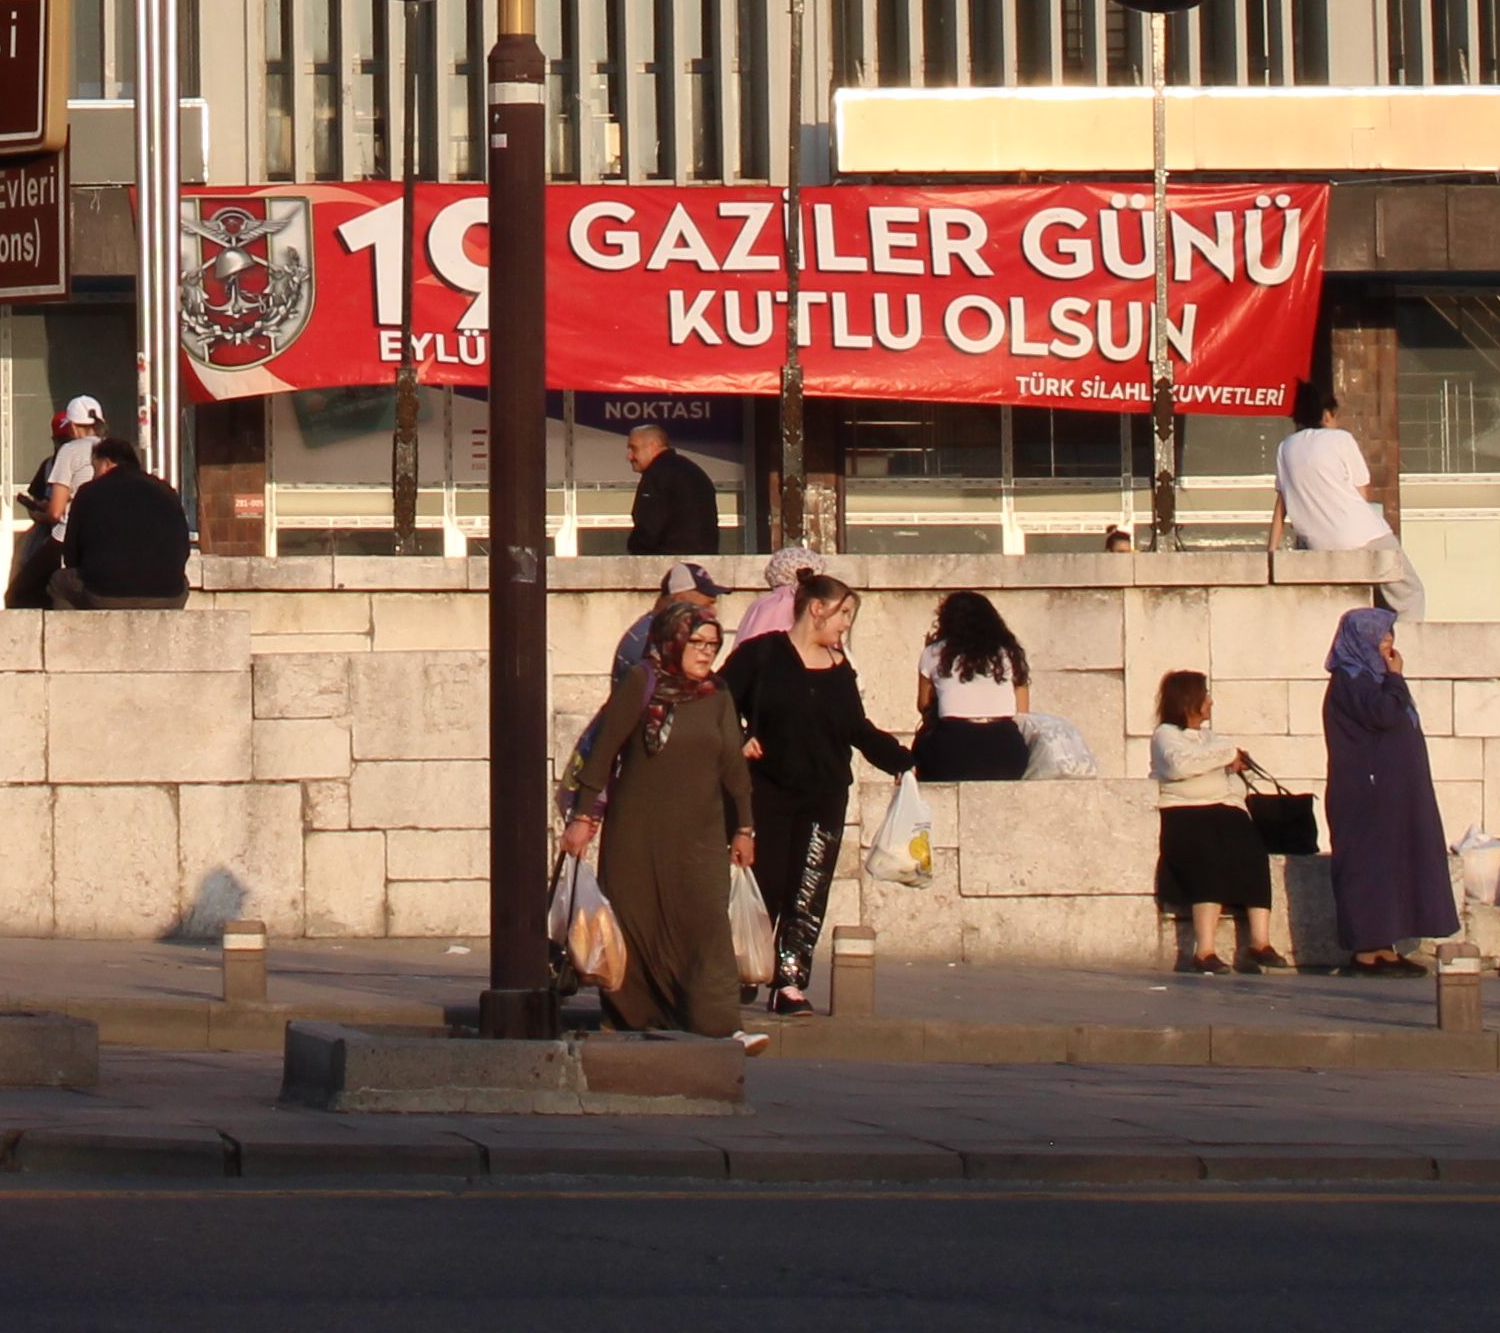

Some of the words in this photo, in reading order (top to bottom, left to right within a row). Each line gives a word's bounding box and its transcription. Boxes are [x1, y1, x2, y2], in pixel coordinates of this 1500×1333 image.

[569, 188, 994, 276] GAZİLER
[1022, 193, 1301, 286] GÜNÜ
[669, 290, 922, 351] KUTLU
[944, 295, 1198, 364] OLSUN
[605, 399, 712, 421] NOKTASI
[1015, 372, 1074, 398] TÜRK
[1080, 375, 1157, 402] SİLAHL
